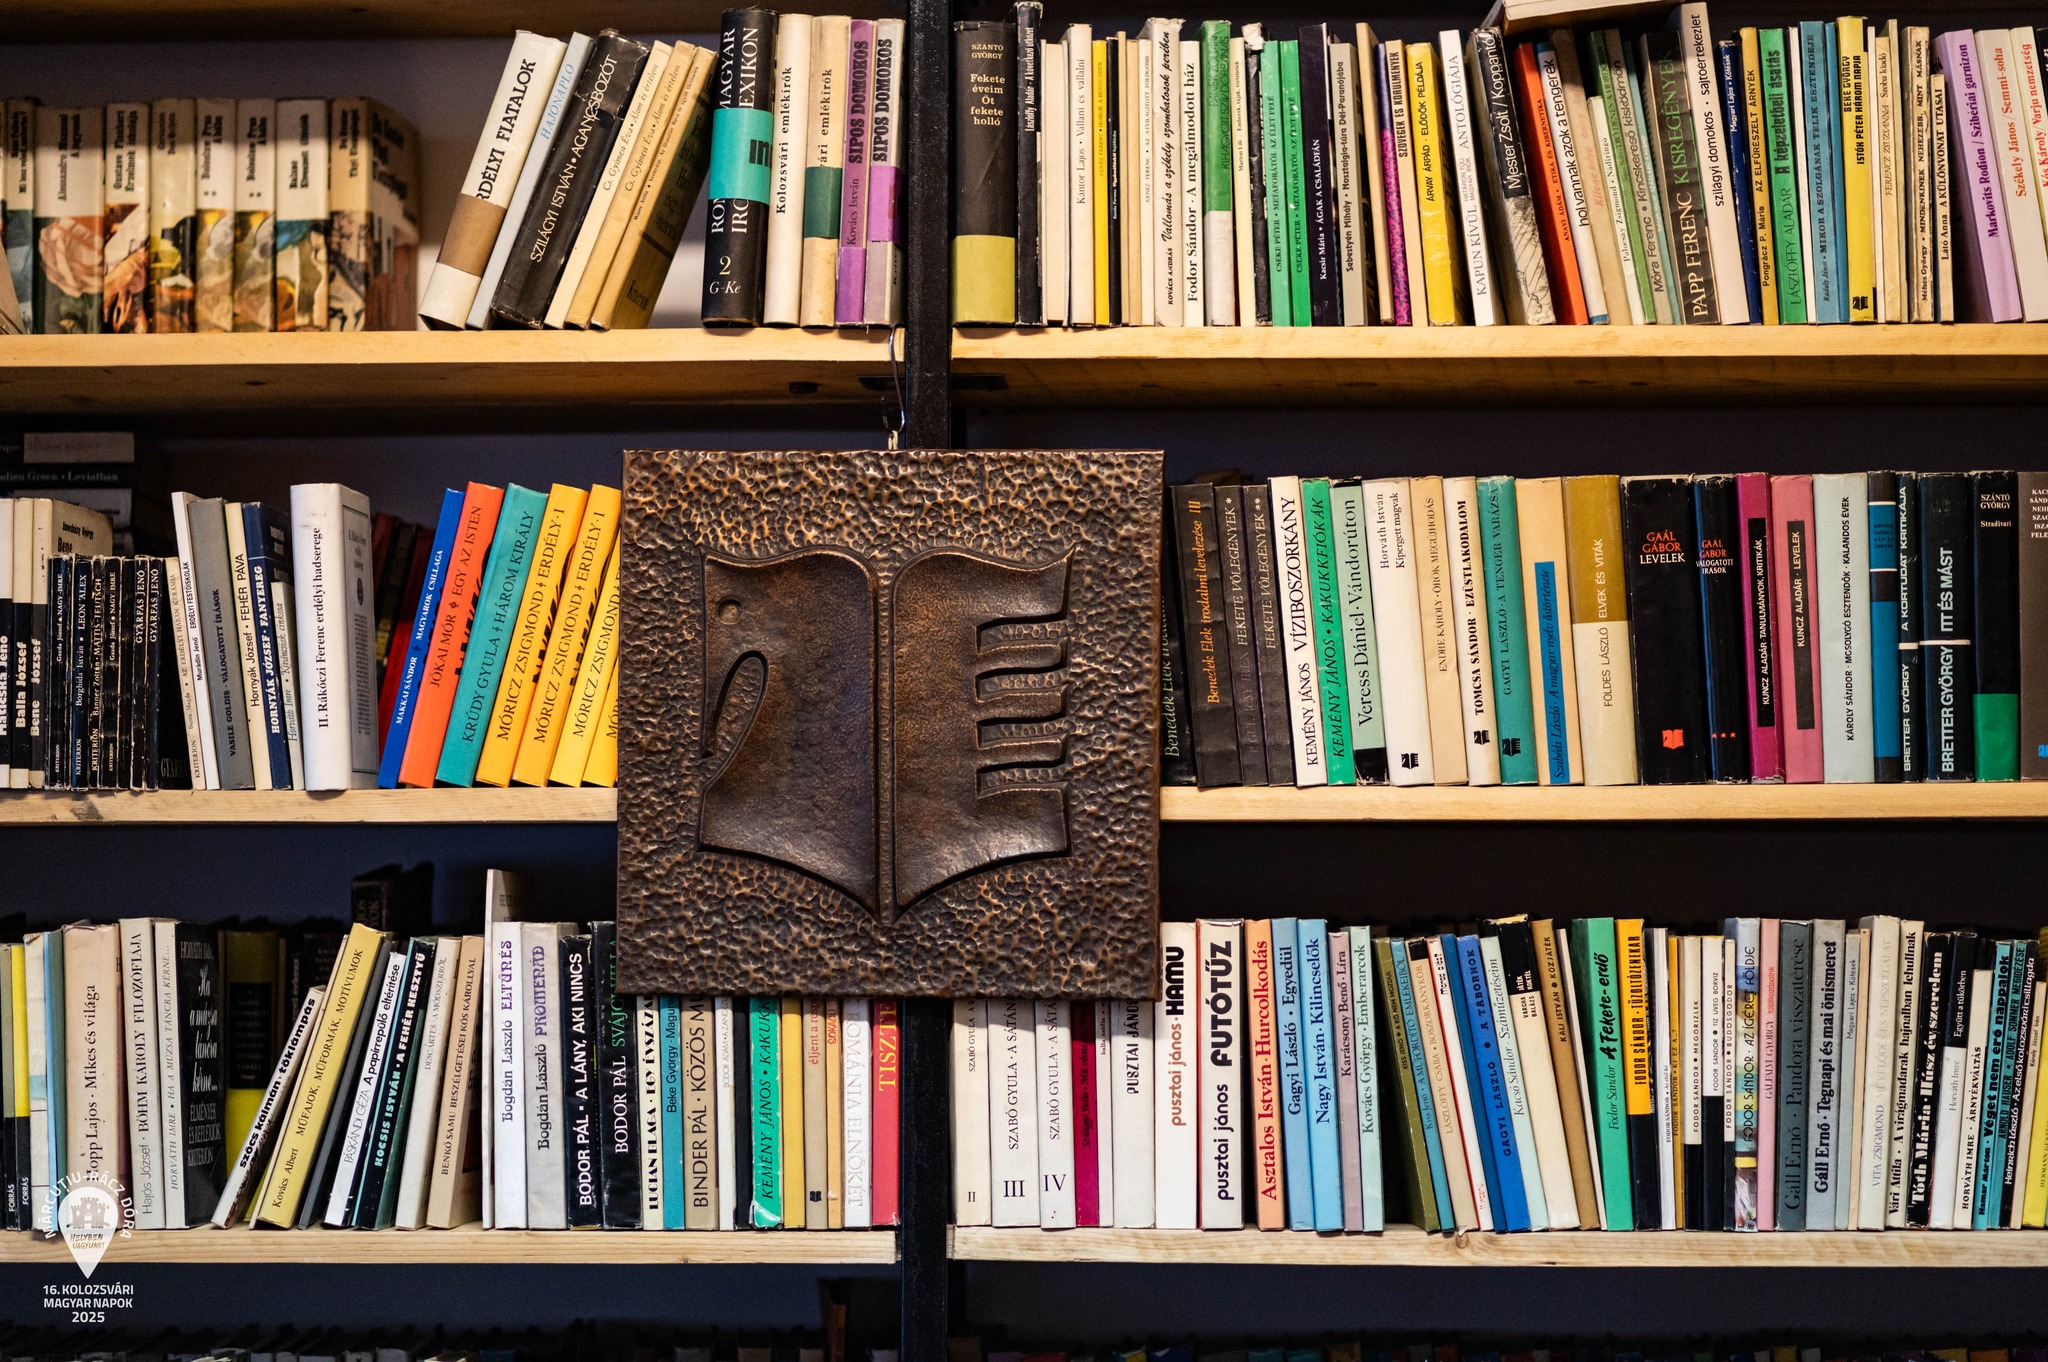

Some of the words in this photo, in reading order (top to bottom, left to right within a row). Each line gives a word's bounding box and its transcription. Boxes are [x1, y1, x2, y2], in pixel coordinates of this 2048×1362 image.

[850, 40, 869, 113] DOMOKOS
[873, 39, 892, 113] DOMOKOS
[970, 74, 1006, 84] Fekete
[1183, 63, 1195, 87] ház
[1415, 62, 1426, 98] PÉLDÁJA
[1853, 56, 1862, 80] NAPJA
[1957, 45, 1976, 89] garnizon
[496, 58, 537, 142] FIATALOK
[778, 67, 792, 133] emlékírók
[972, 86, 1003, 94] éveim
[1446, 56, 1469, 149] ANTOLÓGIÁJA
[1543, 58, 1565, 118] tengerek
[1852, 82, 1863, 113] HÁROM
[971, 107, 1003, 115] fekete
[1557, 119, 1567, 127] a
[1657, 49, 1691, 185] KISREGÉNYEK
[1852, 115, 1864, 138] PÉTER
[1964, 92, 1982, 137] Szibériai
[848, 116, 865, 163] SIPOS
[871, 115, 888, 162] SIPOS
[1184, 92, 1197, 182] megálmodott
[1561, 129, 1574, 157] azok
[1853, 141, 1864, 164] ISTÓK
[529, 210, 560, 263] SZILÁGYI
[549, 163, 577, 208] ISTVÁN
[571, 53, 618, 157] AGANCSBOZÓT
[776, 141, 789, 214] Kolozsvári
[1312, 139, 1322, 189] CSALÁDFÁN
[1422, 145, 1432, 171] ÁRPÁD
[1976, 148, 1992, 184] Rodion
[1185, 186, 1196, 196] A
[1425, 177, 1435, 202] ÁRVAY
[1566, 160, 1585, 207] vannak
[1185, 208, 1197, 256] Sándor
[1313, 200, 1324, 224] ÁGAK
[1466, 205, 1481, 246] KÍVÜL
[1575, 209, 1590, 226] hol
[1676, 192, 1702, 267] FERENC
[1981, 186, 1999, 237] Markovits
[1317, 233, 1326, 254] Mária
[1186, 260, 1198, 301] Fodor
[1317, 256, 1327, 280] Kacsir
[1471, 250, 1487, 295] KAPUN
[1687, 273, 1709, 317] PAPP
[465, 506, 482, 544] ISTEN
[1375, 494, 1386, 523] István
[1392, 493, 1402, 525] magvak
[311, 528, 324, 581] hadserege
[1342, 499, 1363, 602] Vándorúton
[1379, 526, 1390, 569] Horváth
[1394, 528, 1405, 568] Kipergett
[1457, 500, 1475, 607] EZÜSTLAKODALOM
[1593, 538, 1604, 567] VITÁK
[1642, 542, 1682, 553] GÁBOR
[1646, 531, 1674, 541] GAÁL
[1791, 532, 1802, 569] LEVELEK
[235, 554, 246, 581] PÁVA
[459, 548, 471, 566] AZ
[1280, 497, 1308, 651] VÍZIBOSZORKÁNY
[1639, 553, 1686, 565] LEVELEK
[1937, 548, 1952, 588] MÁST
[253, 566, 268, 626] FANYEREG
[452, 569, 467, 596] EGY
[1594, 572, 1606, 584] ÉS
[1791, 579, 1803, 613] ALADÁR
[238, 587, 250, 621] FEHÉR
[312, 584, 324, 623] erdélyi
[1597, 589, 1608, 618] ELVEK
[1937, 592, 1952, 610] ÉS
[439, 614, 457, 645] MÓR
[463, 691, 485, 743] KRÚDY
[477, 637, 500, 689] GYULA
[493, 568, 519, 623] HÁROM
[510, 510, 534, 564] KIRÁLY
[1352, 613, 1368, 666] Dániel
[1466, 618, 1480, 664] SÁNDOR
[1795, 616, 1805, 647] KUNCZ
[1940, 613, 1952, 632] ITT
[15, 642, 27, 687] József
[244, 633, 257, 664] József
[261, 635, 275, 676] JÓZSEF
[314, 626, 326, 663] Ferenc
[247, 667, 260, 707] Hornyák
[429, 647, 449, 687] JÓKAI
[1298, 662, 1315, 703] JÁNOS
[1936, 646, 1955, 706] GYÖRGY
[16, 692, 26, 727] Balla
[266, 679, 281, 734] HORNYÁK
[314, 667, 329, 711] Rákóczi
[1351, 670, 1373, 726] Veress
[1472, 668, 1484, 715] TOMCSA
[318, 714, 329, 728] II.
[1301, 707, 1319, 765] KEMÉNY
[1940, 708, 1954, 772] BRETTER
[334, 949, 363, 1013] MOTÍVUMOK
[570, 953, 583, 1001] NINCS
[1166, 947, 1184, 1016] HAMU
[1280, 946, 1297, 1005] Egyedül
[1306, 938, 1323, 1024] Kilincselők
[1822, 940, 1836, 1009] önismeret
[84, 985, 99, 1027] világa
[1205, 941, 1232, 1066] FUTÓTŰZ
[1252, 941, 1273, 1056] Hurcolkodás
[84, 1030, 97, 1044] és
[398, 1009, 414, 1050] FEHÉR
[572, 1007, 584, 1034] AKI
[1821, 1013, 1834, 1038] mai
[133, 1030, 147, 1085] KÁROLY
[396, 1053, 404, 1063] A
[572, 1039, 587, 1083] LÁNY,
[1167, 1023, 1186, 1067] jános
[1283, 1023, 1298, 1067] László
[1313, 1033, 1326, 1080] István
[1820, 1041, 1833, 1055] és
[84, 1048, 97, 1089] Mikes
[1817, 1058, 1834, 1113] Tegnapi
[134, 1091, 149, 1132] BÖHM
[384, 1071, 400, 1117] ISTVÁN
[575, 1087, 587, 1099] A
[1168, 1071, 1186, 1126] pusztai
[1212, 1084, 1234, 1132] jános
[1257, 1064, 1274, 1120] István
[1286, 1073, 1302, 1115] Gagyi
[1316, 1084, 1331, 1123] Nagy
[375, 1121, 390, 1166] KOCSIS
[574, 1115, 589, 1144] PÁL
[1817, 1123, 1831, 1158] Ernő
[577, 1149, 592, 1206] BODOR
[1044, 1174, 1066, 1191] IV
[1212, 1138, 1234, 1200] pusztai
[1260, 1125, 1278, 1201] Asztalos
[1814, 1162, 1829, 1193] Gáll
[7, 1184, 15, 1212] FORRÁS
[1003, 1180, 1025, 1198] III
